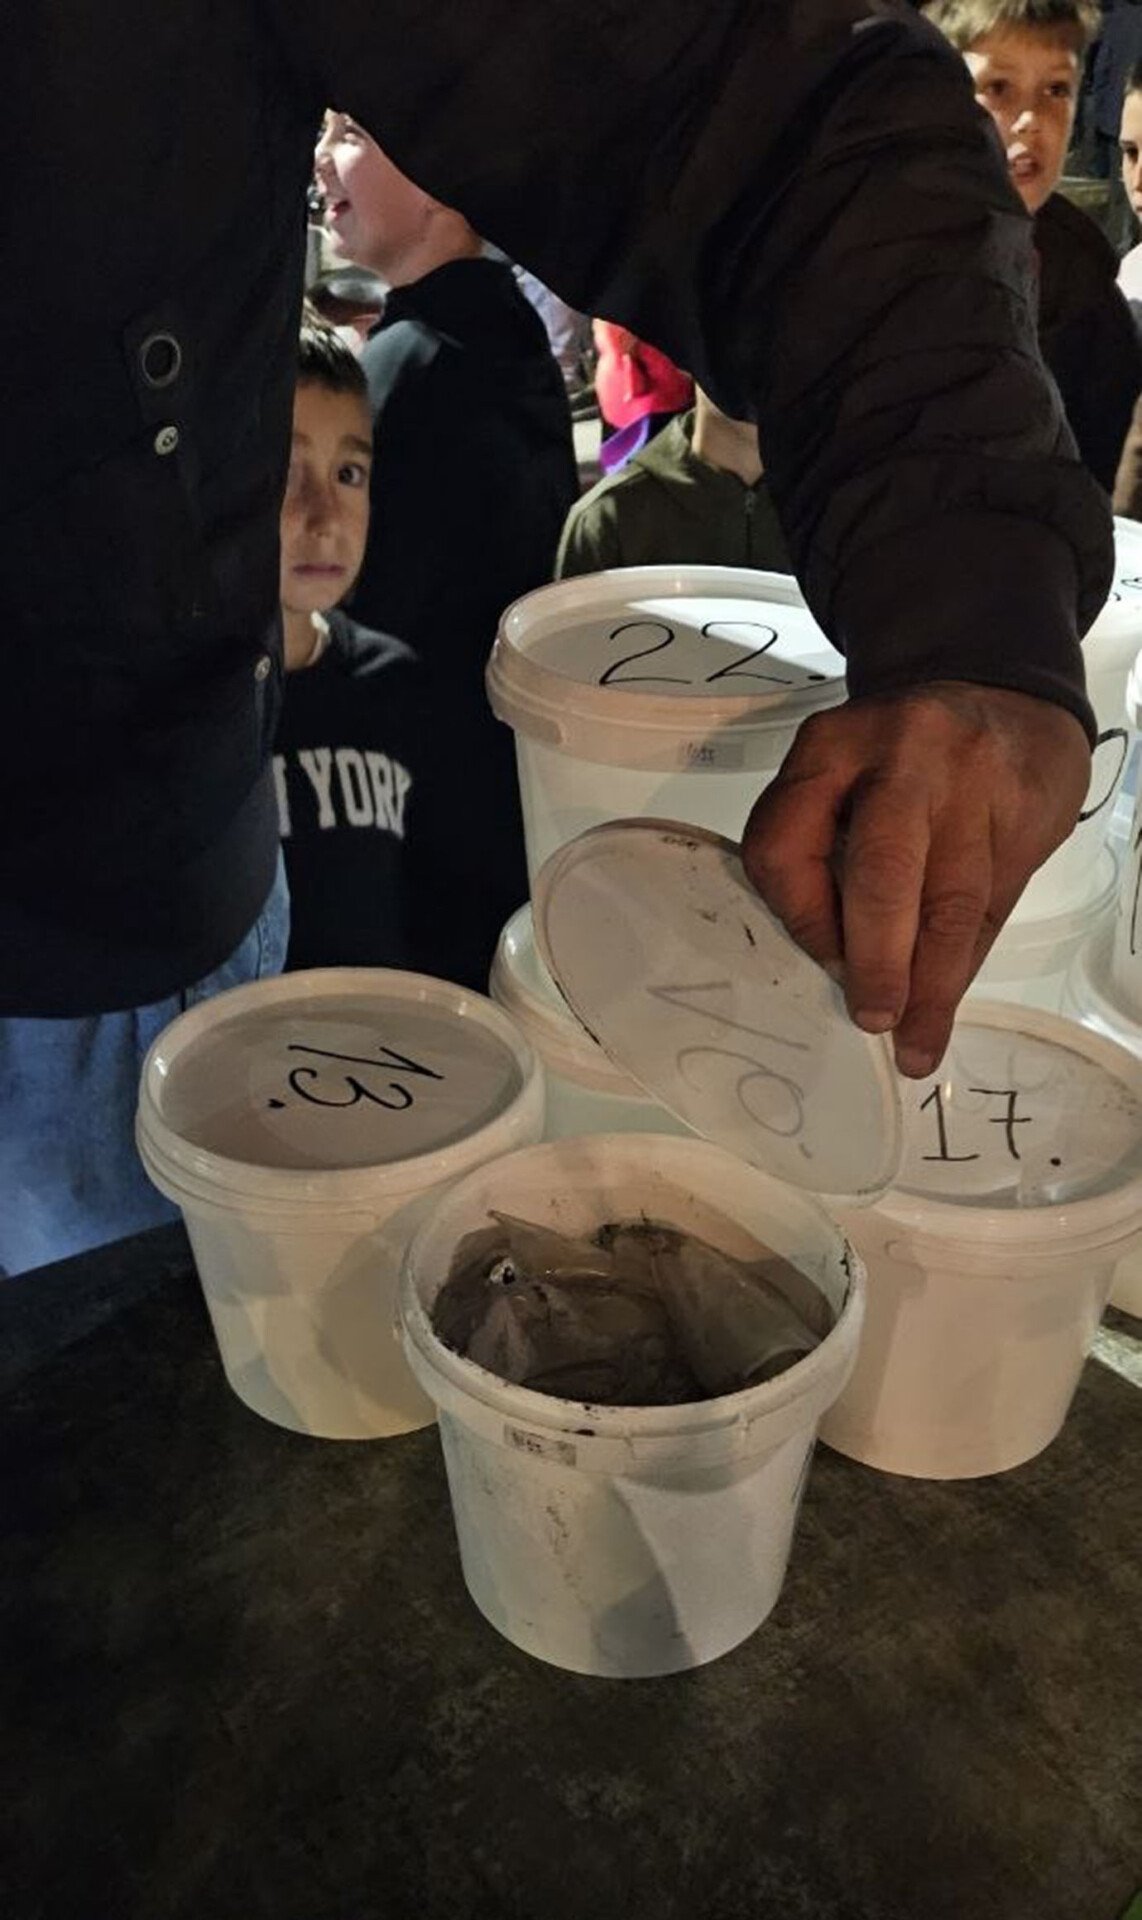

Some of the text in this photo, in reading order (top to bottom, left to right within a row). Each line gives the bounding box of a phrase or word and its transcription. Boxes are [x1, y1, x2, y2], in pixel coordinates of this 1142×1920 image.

[599, 620, 826, 686] 22.
[268, 1044, 445, 1110] 13.
[920, 1084, 1061, 1166] 17.
